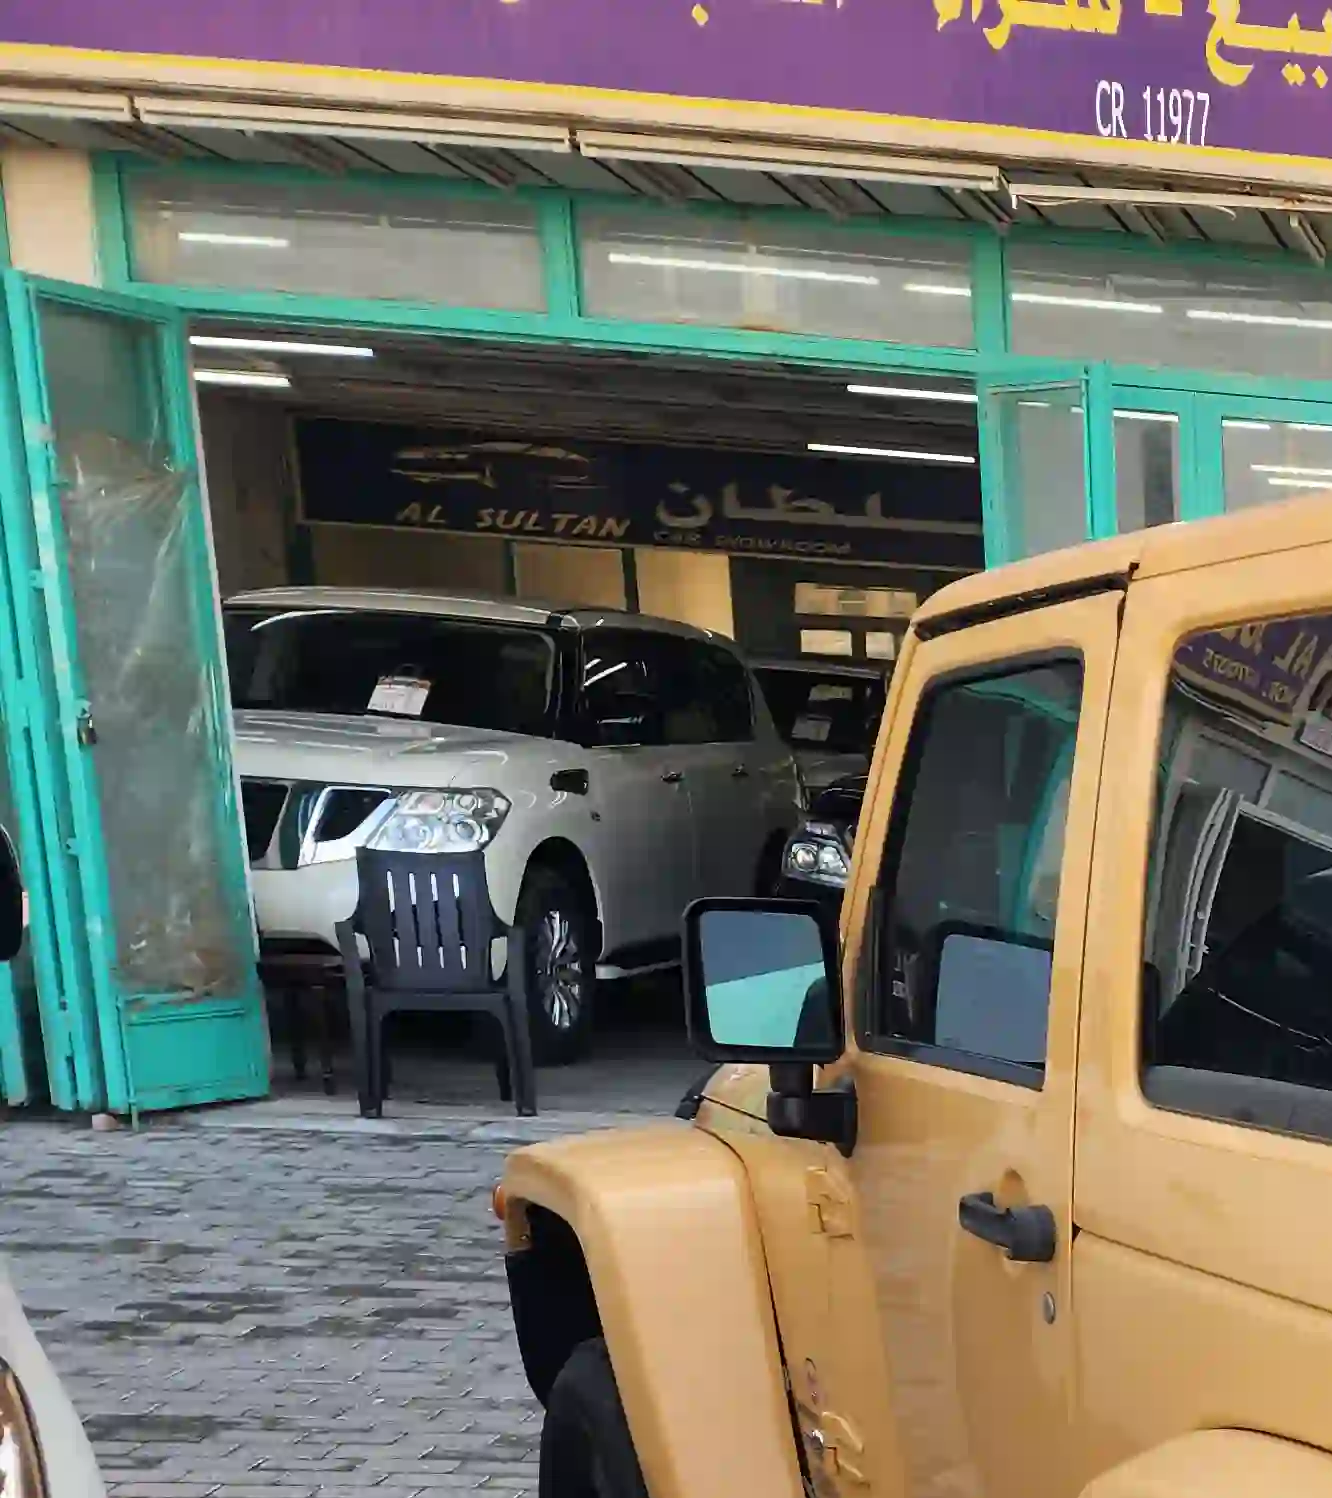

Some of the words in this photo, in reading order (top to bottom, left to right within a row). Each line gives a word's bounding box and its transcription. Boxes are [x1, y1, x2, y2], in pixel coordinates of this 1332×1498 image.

[1095, 79, 1128, 138] CR
[1142, 84, 1210, 147] 11977
[396, 502, 446, 524] AL
[476, 507, 631, 538] SULTAN
